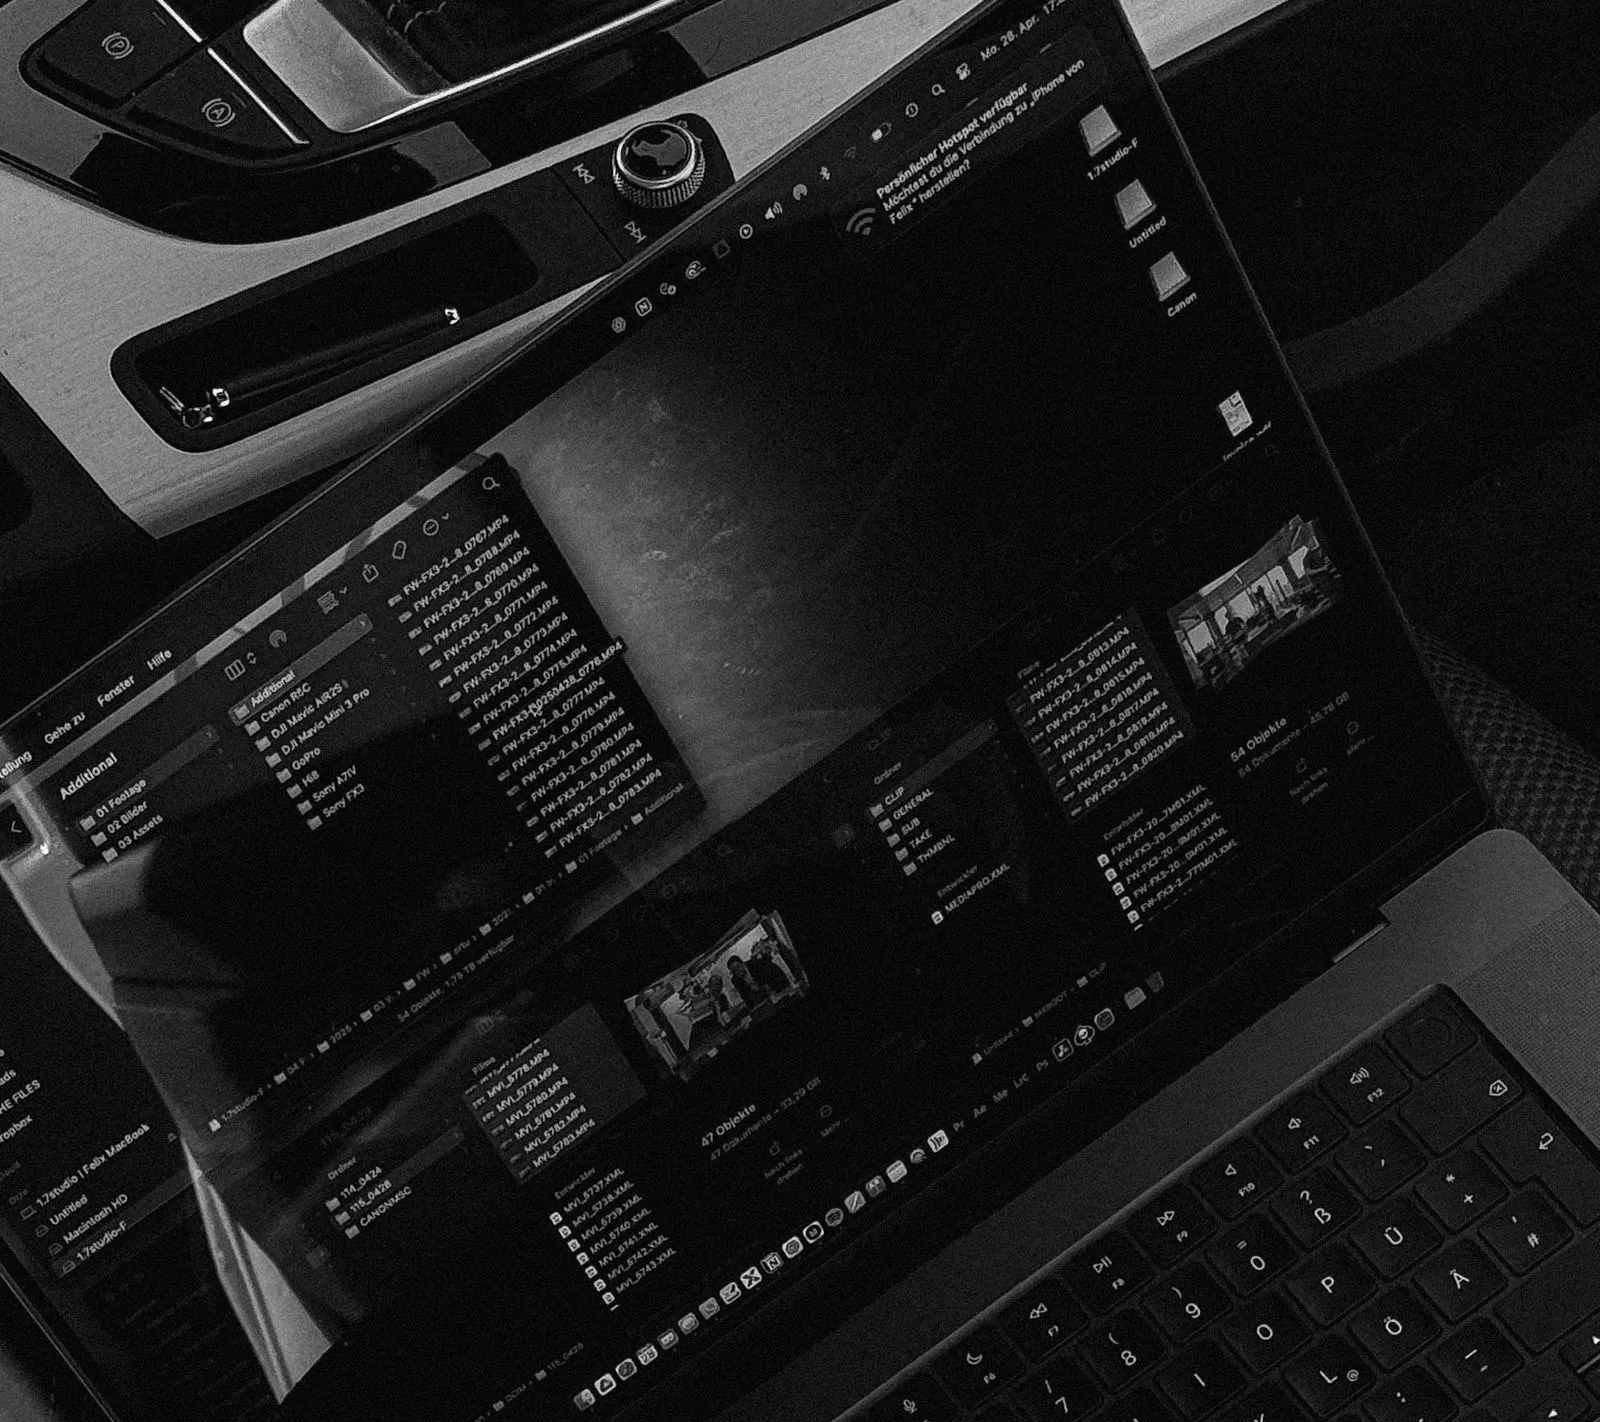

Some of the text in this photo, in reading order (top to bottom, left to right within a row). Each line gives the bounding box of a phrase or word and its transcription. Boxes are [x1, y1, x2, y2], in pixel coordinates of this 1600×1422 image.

[876, 82, 1027, 199] Persönlicher Hotspot verfügbar
[882, 173, 929, 211] Möchtest
[929, 164, 943, 178] du
[943, 152, 959, 168] die
[958, 111, 1014, 154] Verbindung
[1014, 101, 1028, 116] zu
[1065, 59, 1084, 77] von
[918, 158, 970, 203] herstellen?
[1128, 216, 1166, 248] Untitled
[1167, 292, 1197, 317] Canon
[44, 722, 72, 744] Gehe
[72, 711, 85, 725] zu
[96, 675, 134, 706] Fenster
[146, 650, 172, 670] Hilfe
[251, 669, 295, 707] Additional
[260, 698, 291, 722] Canon
[286, 704, 315, 726] Mavic
[297, 720, 326, 743] Mavic
[324, 705, 345, 723] Mini
[344, 699, 352, 708] 3
[352, 688, 370, 703] Pro
[291, 747, 321, 770] GoPro
[1230, 746, 1246, 762] 54
[60, 752, 117, 800] Additional
[96, 779, 146, 818] 01 Footage
[312, 782, 336, 802] Sony
[884, 786, 904, 805] CLIP
[893, 788, 933, 820] GENERAL
[107, 801, 147, 833] 02 Bilder
[322, 797, 346, 818] Sony
[118, 814, 163, 849] 03 Assets
[909, 829, 932, 848] TAKE
[12, 1079, 40, 1103] FILES
[701, 1104, 756, 1146] 47 Objekte
[82, 1154, 105, 1174] Felix
[105, 1123, 150, 1157] MacBook
[1303, 1135, 1319, 1149] F11
[49, 1194, 88, 1225] Untitled
[62, 1193, 128, 1243] Macintosh HD
[1384, 1226, 1403, 1245] Ü
[1320, 1276, 1334, 1293] P
[1185, 1302, 1201, 1318] 9
[1256, 1323, 1273, 1340] O
[1383, 1316, 1403, 1335] Ö
[1120, 1350, 1137, 1366] 8
[1319, 1370, 1337, 1384] L
[1055, 1396, 1068, 1413] 7
